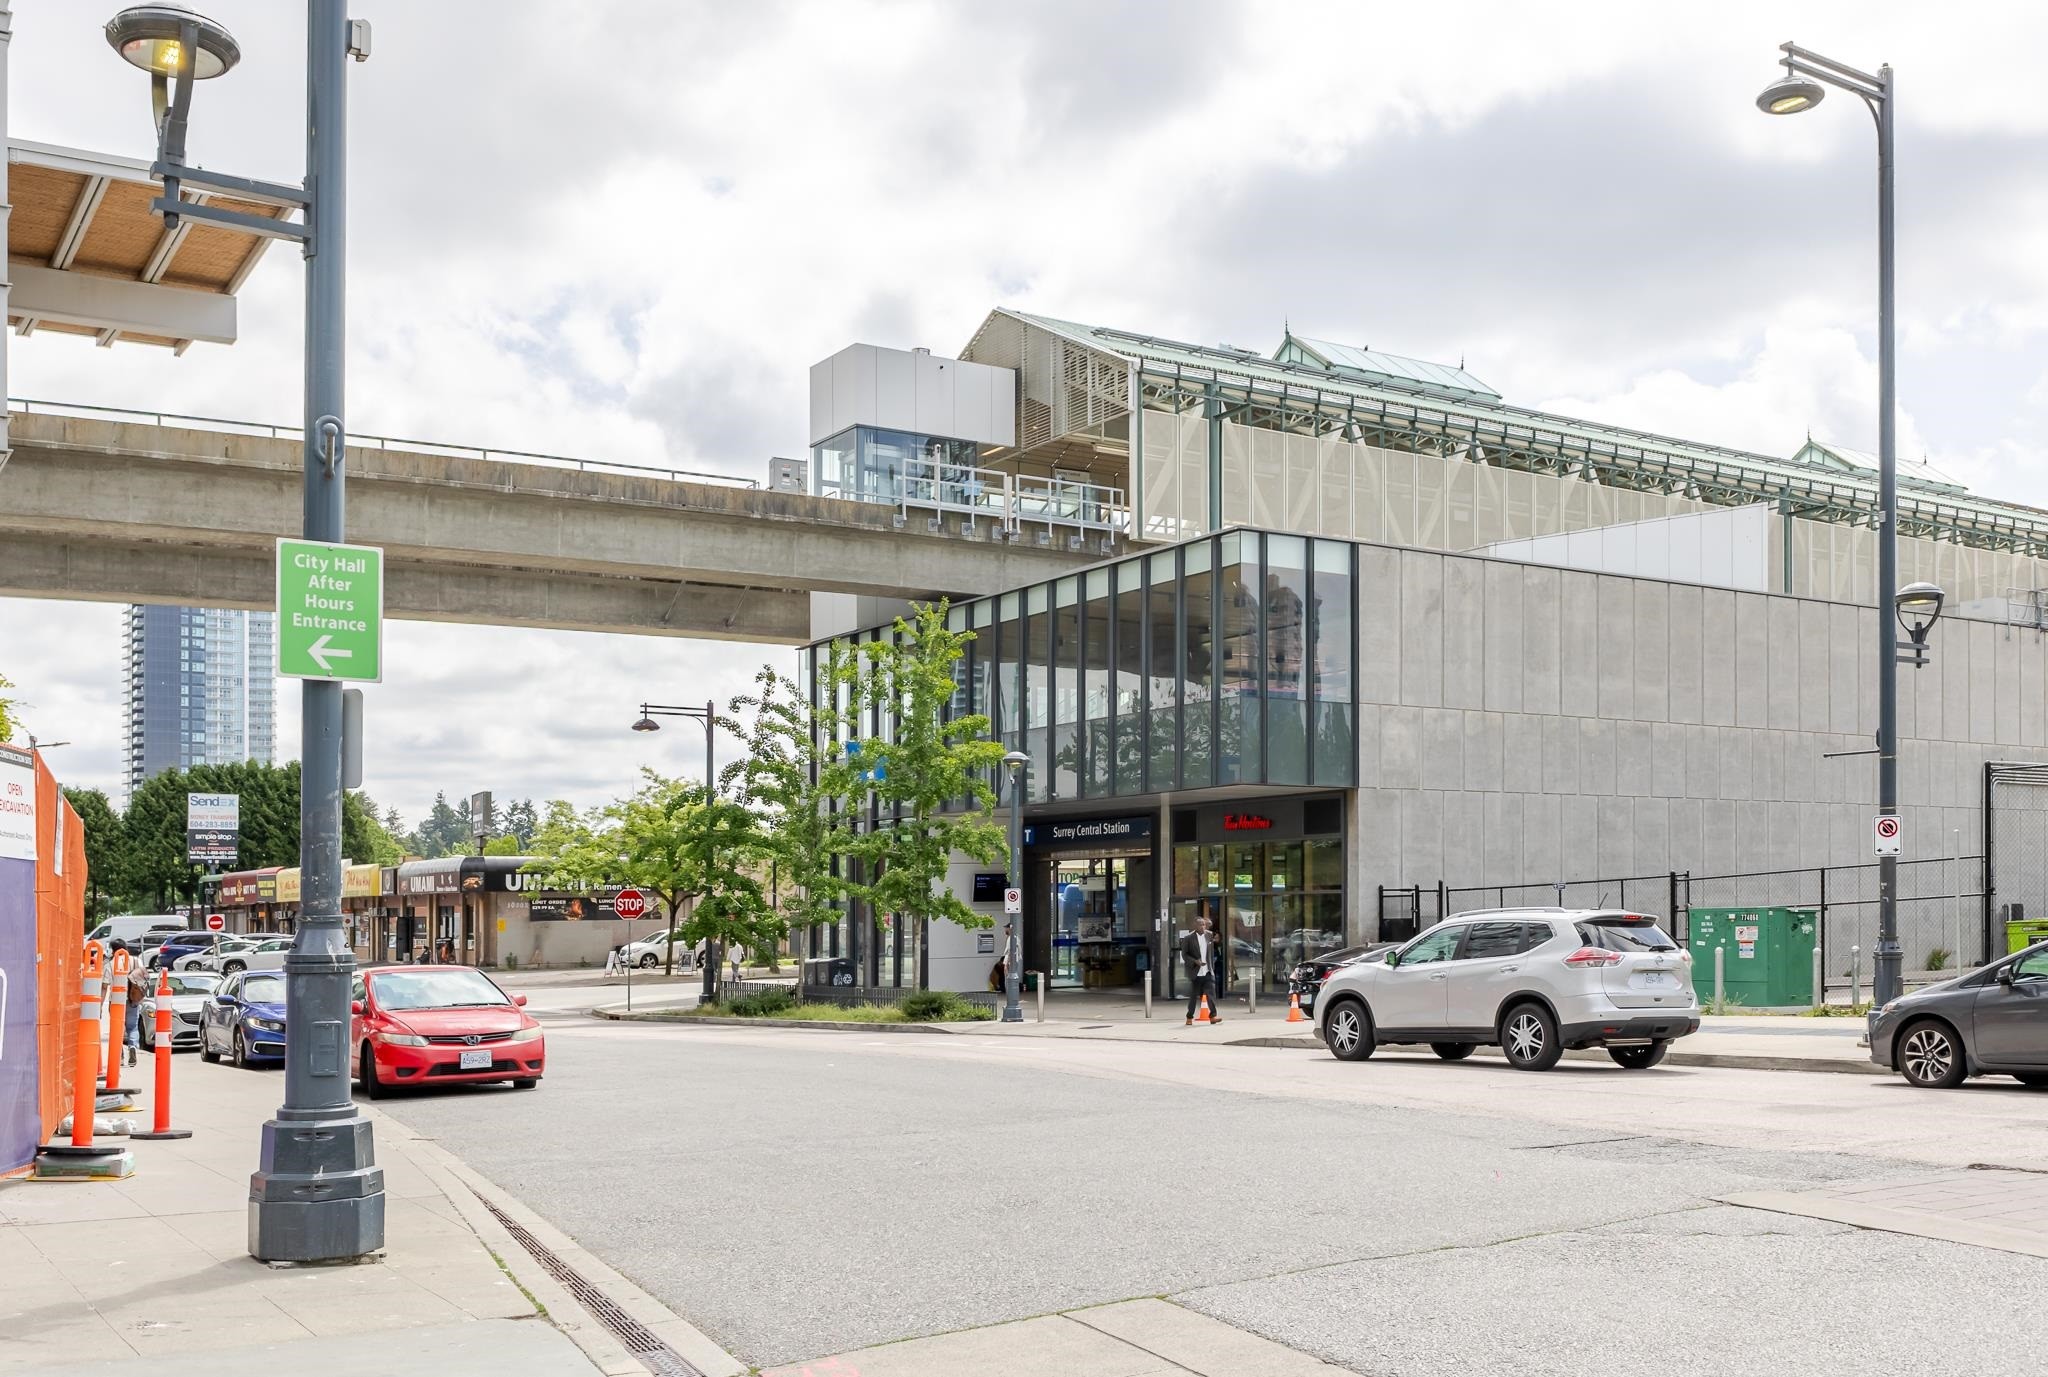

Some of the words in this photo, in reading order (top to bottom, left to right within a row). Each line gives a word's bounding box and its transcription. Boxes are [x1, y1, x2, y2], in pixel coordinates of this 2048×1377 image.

[294, 553, 328, 573] City
[334, 557, 366, 573] Hall
[308, 574, 352, 591] After
[305, 593, 354, 612] Hours
[293, 612, 367, 631] Entrance
[8, 782, 23, 796] OPEN
[1053, 826, 1075, 839] Surrey
[1076, 823, 1102, 836] Central
[1103, 822, 1130, 834] Station
[410, 875, 435, 893] UMAMI
[593, 883, 623, 891] Rmen
[616, 898, 643, 911] STOP
